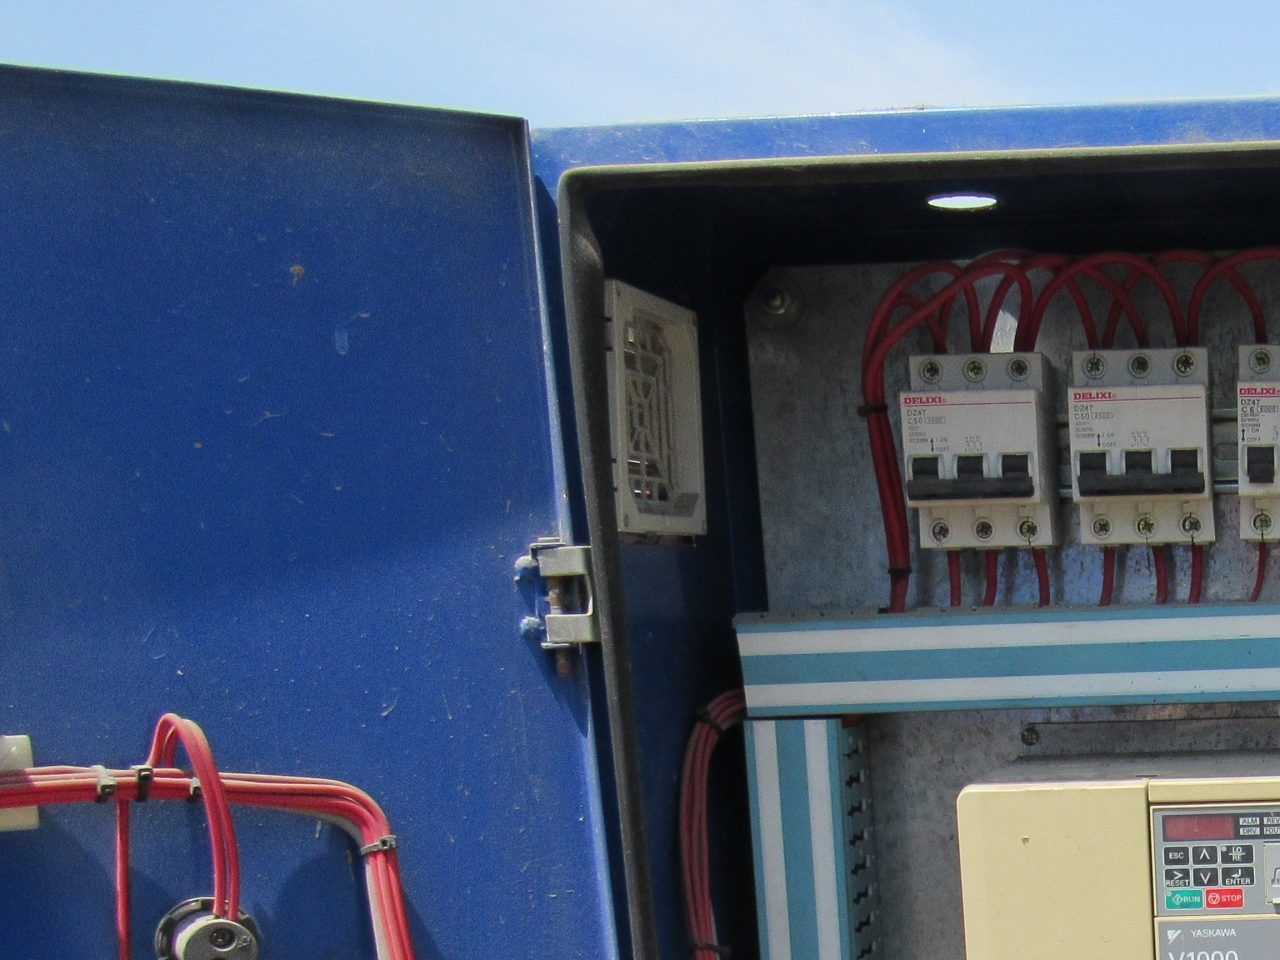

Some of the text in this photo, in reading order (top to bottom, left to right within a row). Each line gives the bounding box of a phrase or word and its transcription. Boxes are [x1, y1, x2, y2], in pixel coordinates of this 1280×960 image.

[1073, 392, 1112, 400] DELIXI
[1225, 877, 1251, 885] ENTER
[1221, 894, 1242, 902] STOP
[1191, 928, 1237, 938] YASKAWA
